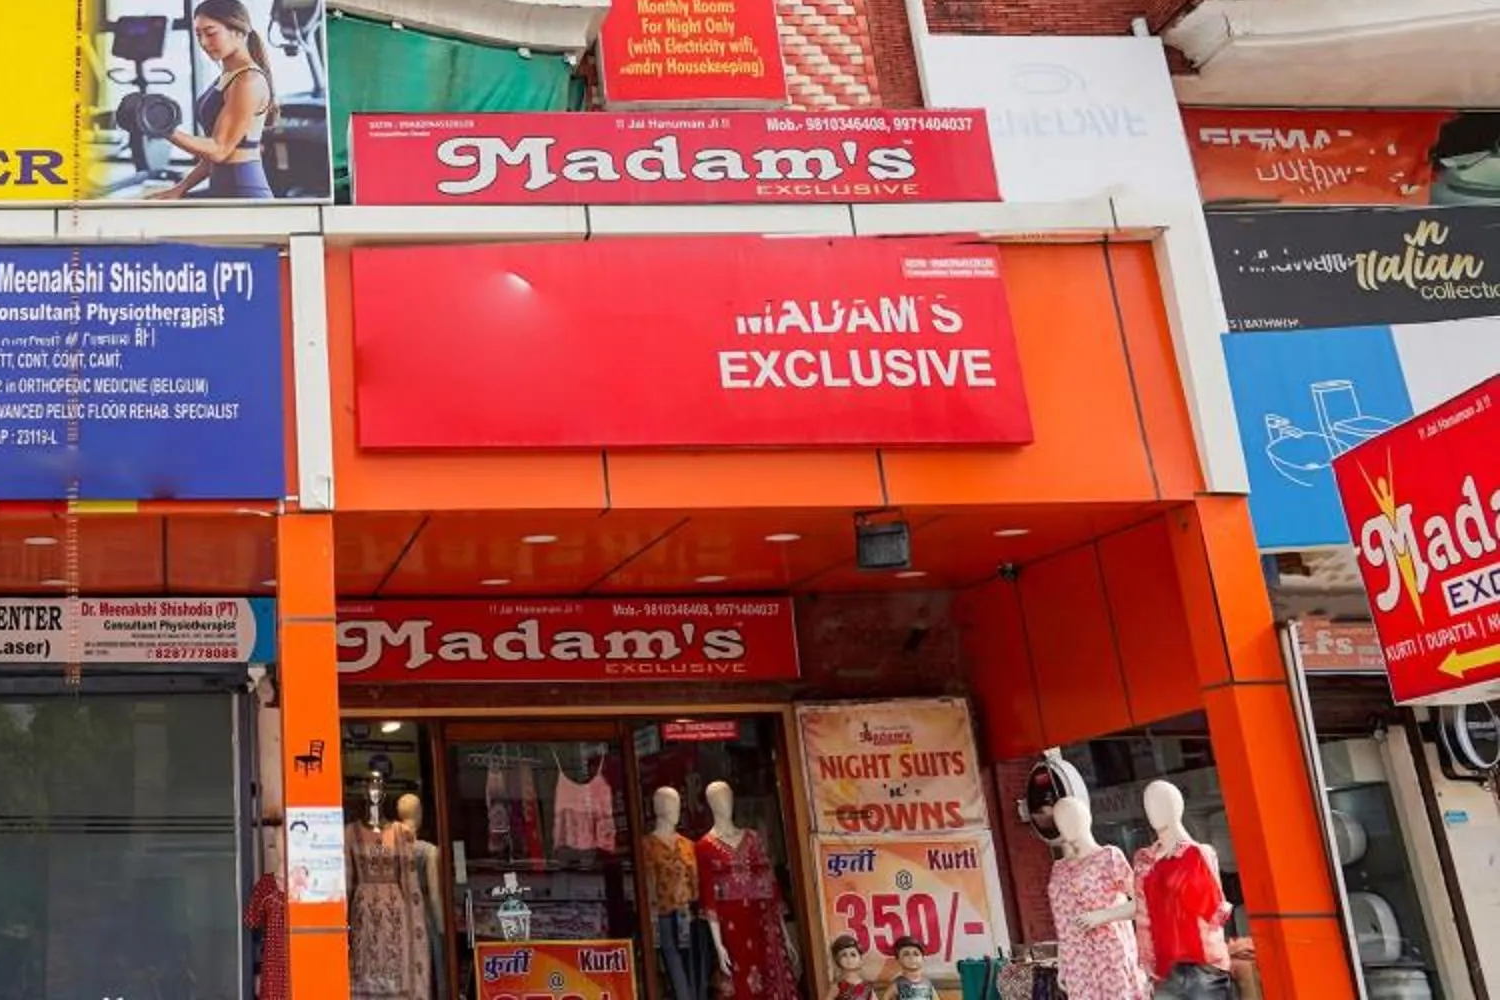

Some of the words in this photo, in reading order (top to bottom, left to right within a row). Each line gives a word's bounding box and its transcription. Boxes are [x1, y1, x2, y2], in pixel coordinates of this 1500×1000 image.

[641, 18, 662, 33] For
[666, 18, 701, 37] Night
[705, 17, 735, 37] Only
[628, 37, 661, 57] (with
[665, 37, 725, 56] Electricity
[666, 57, 765, 77] Housekeeping)
[648, 118, 705, 130] Hanuman
[436, 134, 916, 195] Madam's
[756, 184, 921, 195] EXCLUSIVE
[109, 262, 207, 293] Shishodia
[213, 262, 254, 300] (PT)
[86, 303, 226, 328] Physiotherapist
[718, 348, 997, 388] EXCLUSIVE
[19, 378, 92, 394] ORTHOPEDIC
[94, 378, 149, 394] MEDICINE
[150, 378, 209, 397] (BELGIUM)
[87, 403, 128, 419] FLOOR
[174, 403, 240, 420] SPECIALIST
[81, 602, 97, 616] Dr.
[100, 602, 157, 616] Meenakshi
[160, 602, 213, 616] Shishodia
[215, 601, 239, 618] (PT)
[103, 620, 157, 630] Consultant
[159, 619, 237, 632] Physiotherapist
[1425, 621, 1477, 650] DUPATTA
[336, 618, 746, 674] Madam's
[605, 662, 748, 674] EXCLUSIVE
[818, 753, 892, 780] NIGHT
[900, 751, 967, 778] SUITS
[834, 800, 966, 832] GOWNS
[927, 847, 979, 871] Kurti
[895, 870, 913, 890] @
[835, 892, 984, 963] 350/-
[578, 947, 629, 973] Kurti
[549, 971, 566, 990] @
